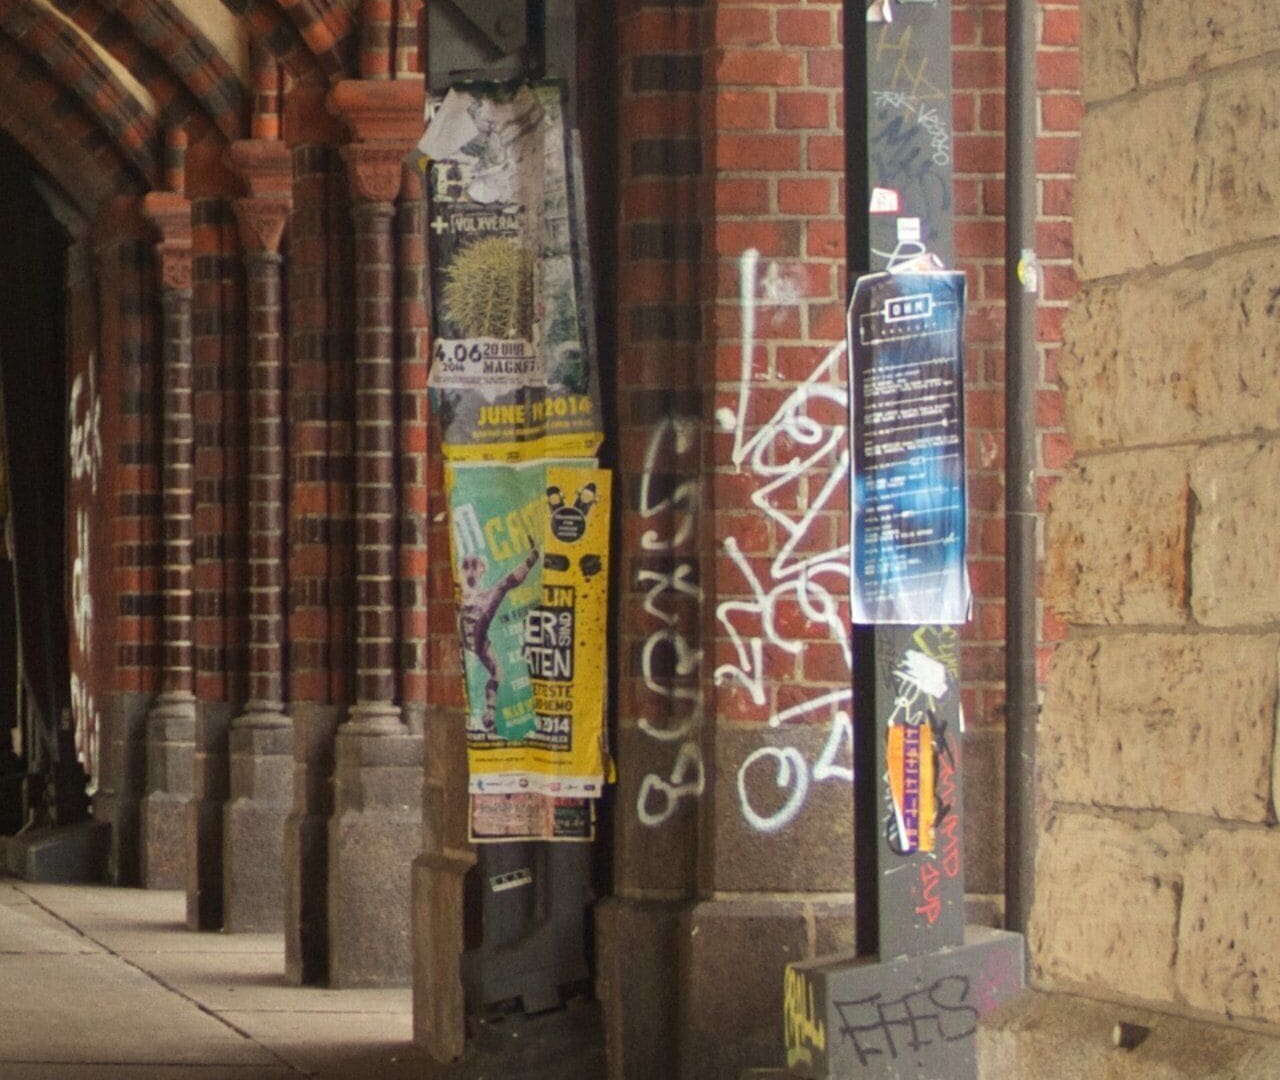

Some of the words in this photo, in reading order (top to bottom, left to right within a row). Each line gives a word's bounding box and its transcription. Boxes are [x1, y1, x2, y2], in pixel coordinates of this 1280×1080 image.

[892, 301, 925, 316] OHM
[479, 405, 525, 426] JUNE
[544, 395, 592, 417] 2014
